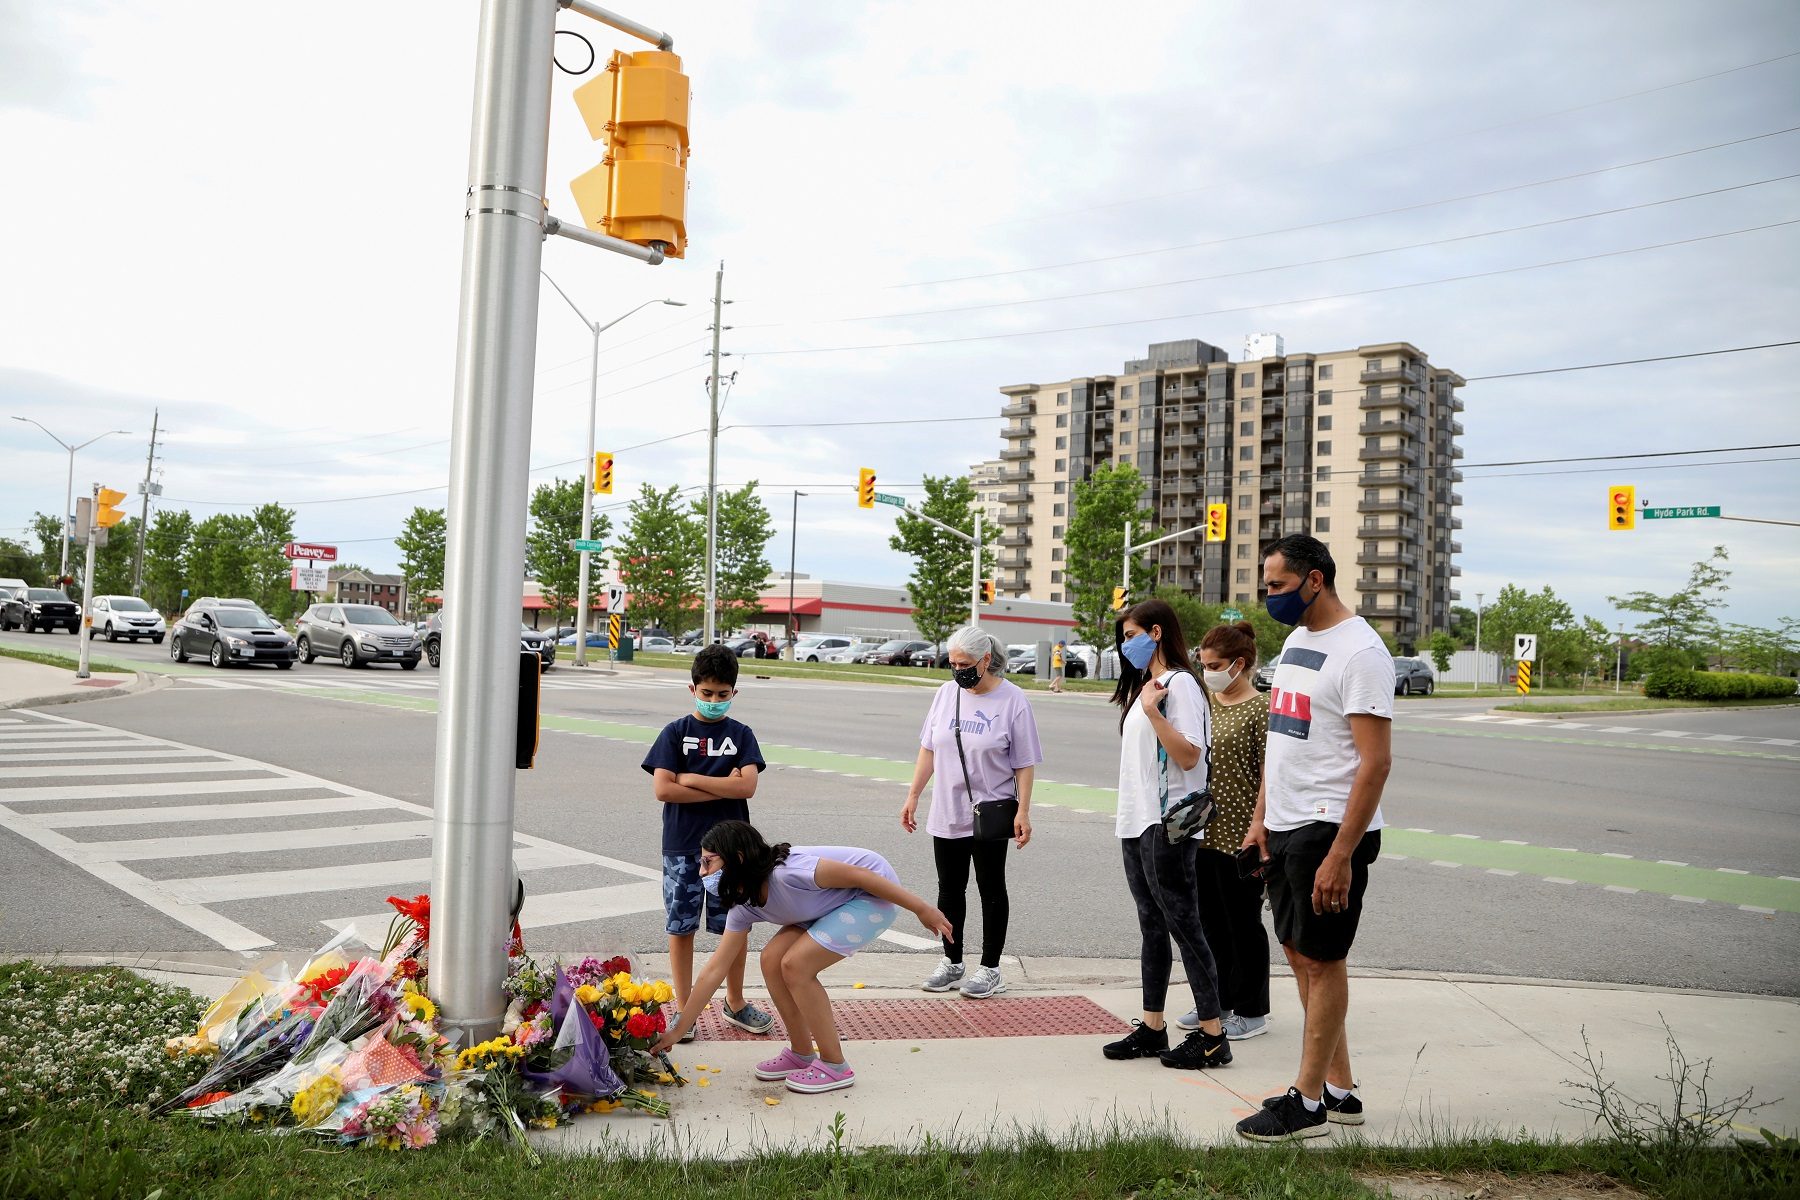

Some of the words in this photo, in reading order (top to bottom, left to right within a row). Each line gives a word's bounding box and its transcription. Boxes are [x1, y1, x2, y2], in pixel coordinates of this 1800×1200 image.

[1654, 509, 1673, 518] Hyde
[1676, 507, 1694, 516] Park
[1697, 507, 1709, 516] Rd.
[293, 545, 324, 558] Peavey
[949, 719, 985, 735] PUMA
